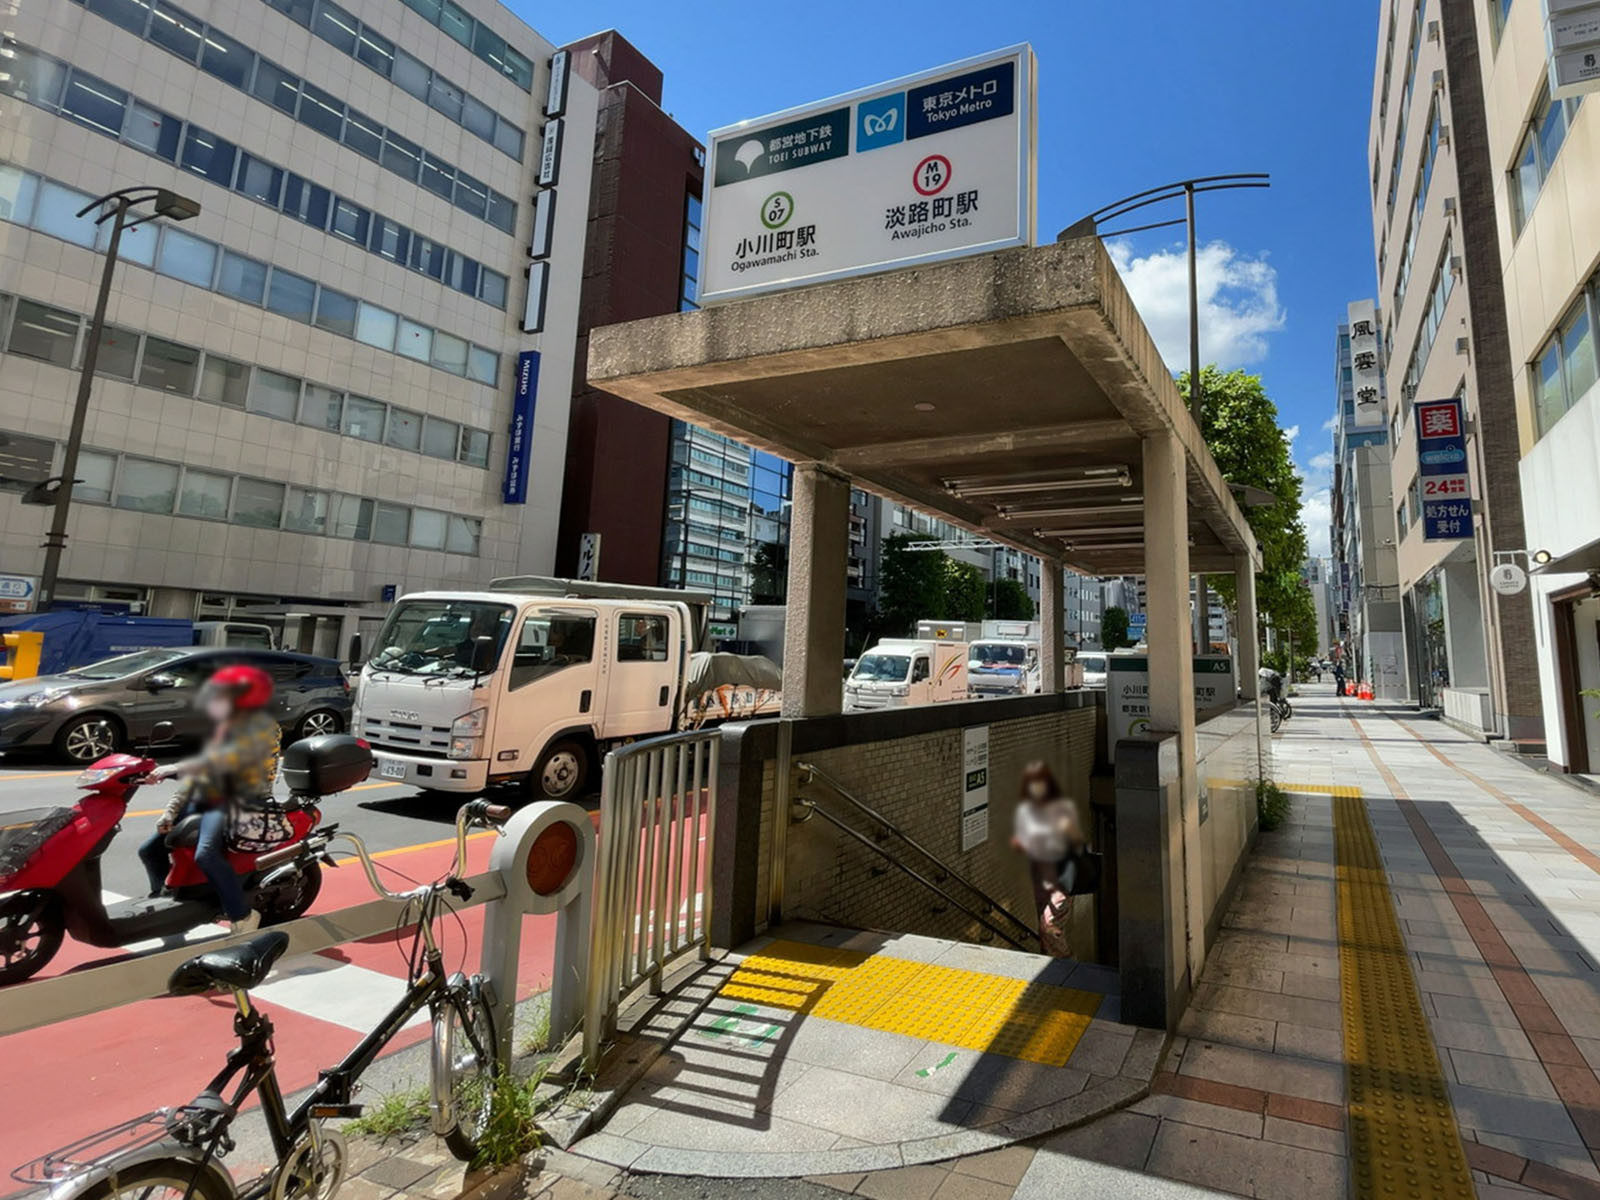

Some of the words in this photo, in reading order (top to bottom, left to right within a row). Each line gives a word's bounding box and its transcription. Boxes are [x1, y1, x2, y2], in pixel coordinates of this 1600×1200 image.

[922, 79, 997, 112] 東京メトロ
[926, 106, 958, 124] Tokyo
[959, 98, 993, 117] Metro
[768, 125, 832, 152] 都営地下鉄
[768, 153, 789, 165] TOEI
[791, 140, 832, 161] SUBWAY
[924, 173, 941, 187] 19
[926, 162, 939, 174] M
[768, 207, 785, 222] 07
[774, 198, 781, 208] S
[885, 190, 979, 230] 淡路町駅
[891, 222, 946, 241] Awajicho
[949, 217, 972, 231] Sta.
[735, 225, 816, 259] 小川町駅
[731, 248, 797, 273] Ogawamachi
[799, 246, 820, 259] Sta.
[519, 359, 531, 396] MIZUHO
[1424, 409, 1454, 434] 薬
[1426, 504, 1469, 519] 処方せん
[1437, 519, 1461, 534] 受付
